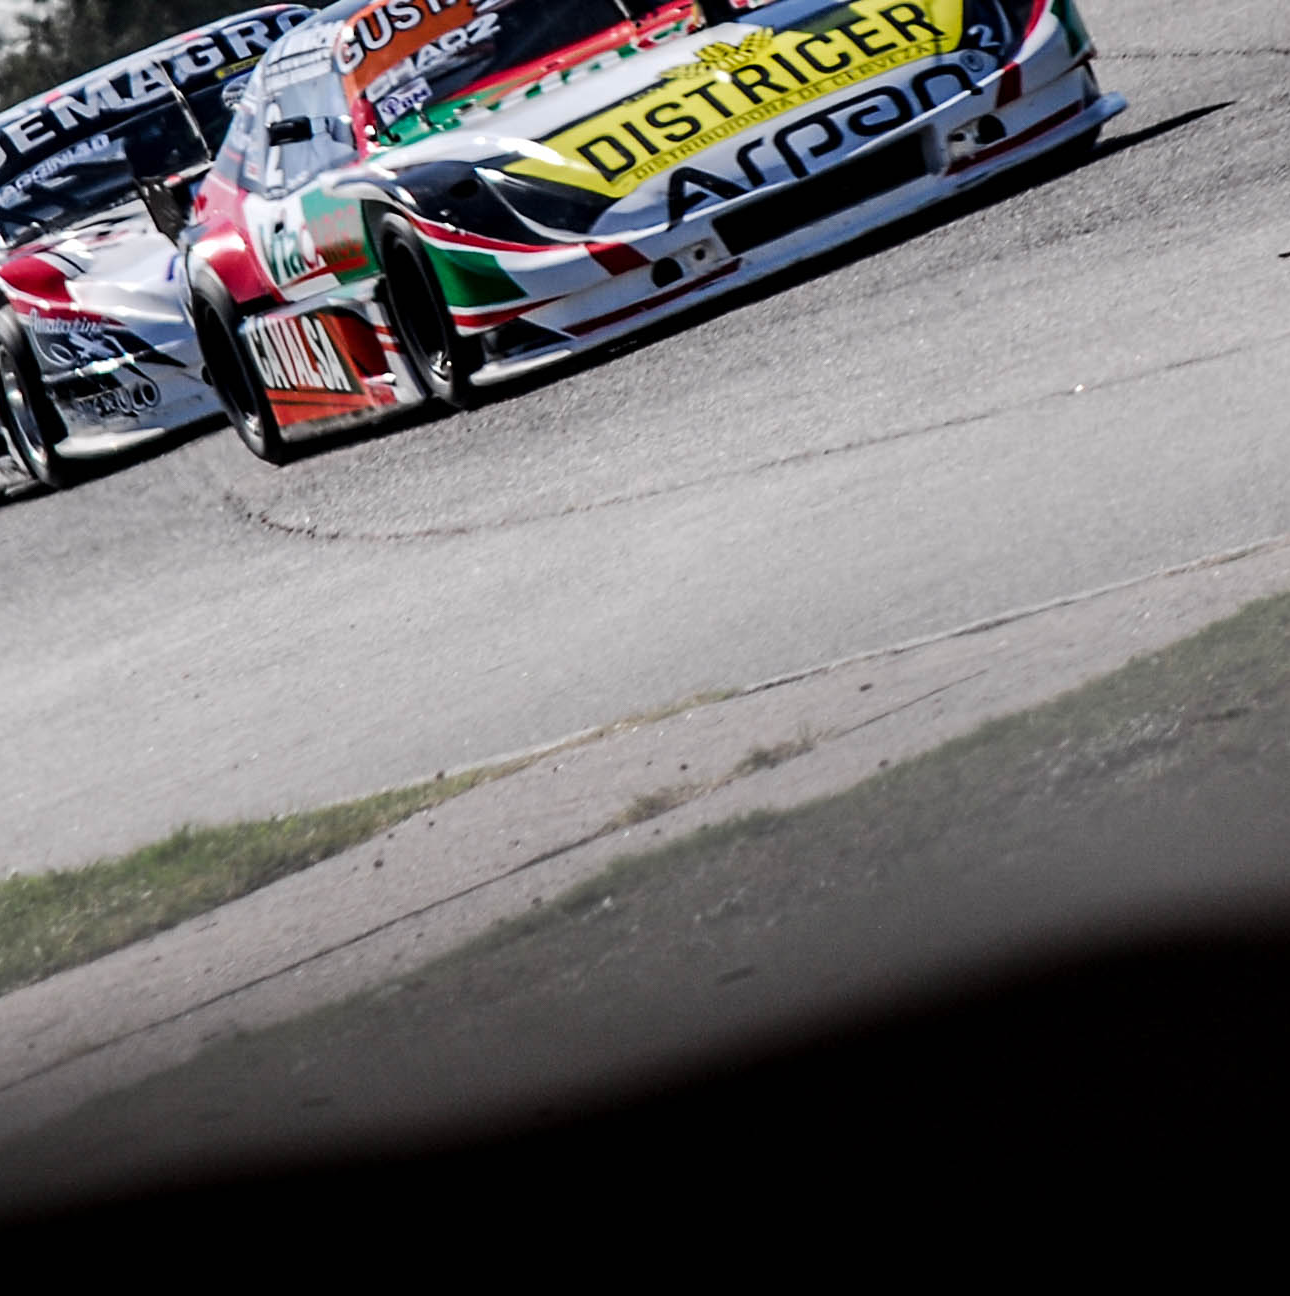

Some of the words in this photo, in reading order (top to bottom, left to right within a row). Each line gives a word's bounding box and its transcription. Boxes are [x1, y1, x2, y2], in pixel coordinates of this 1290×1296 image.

[576, 1, 945, 183] DISTRICER
[632, 90, 796, 181] DISTRIBUIDORA
[798, 79, 829, 101] DE
[243, 316, 353, 392] CAVALSA
